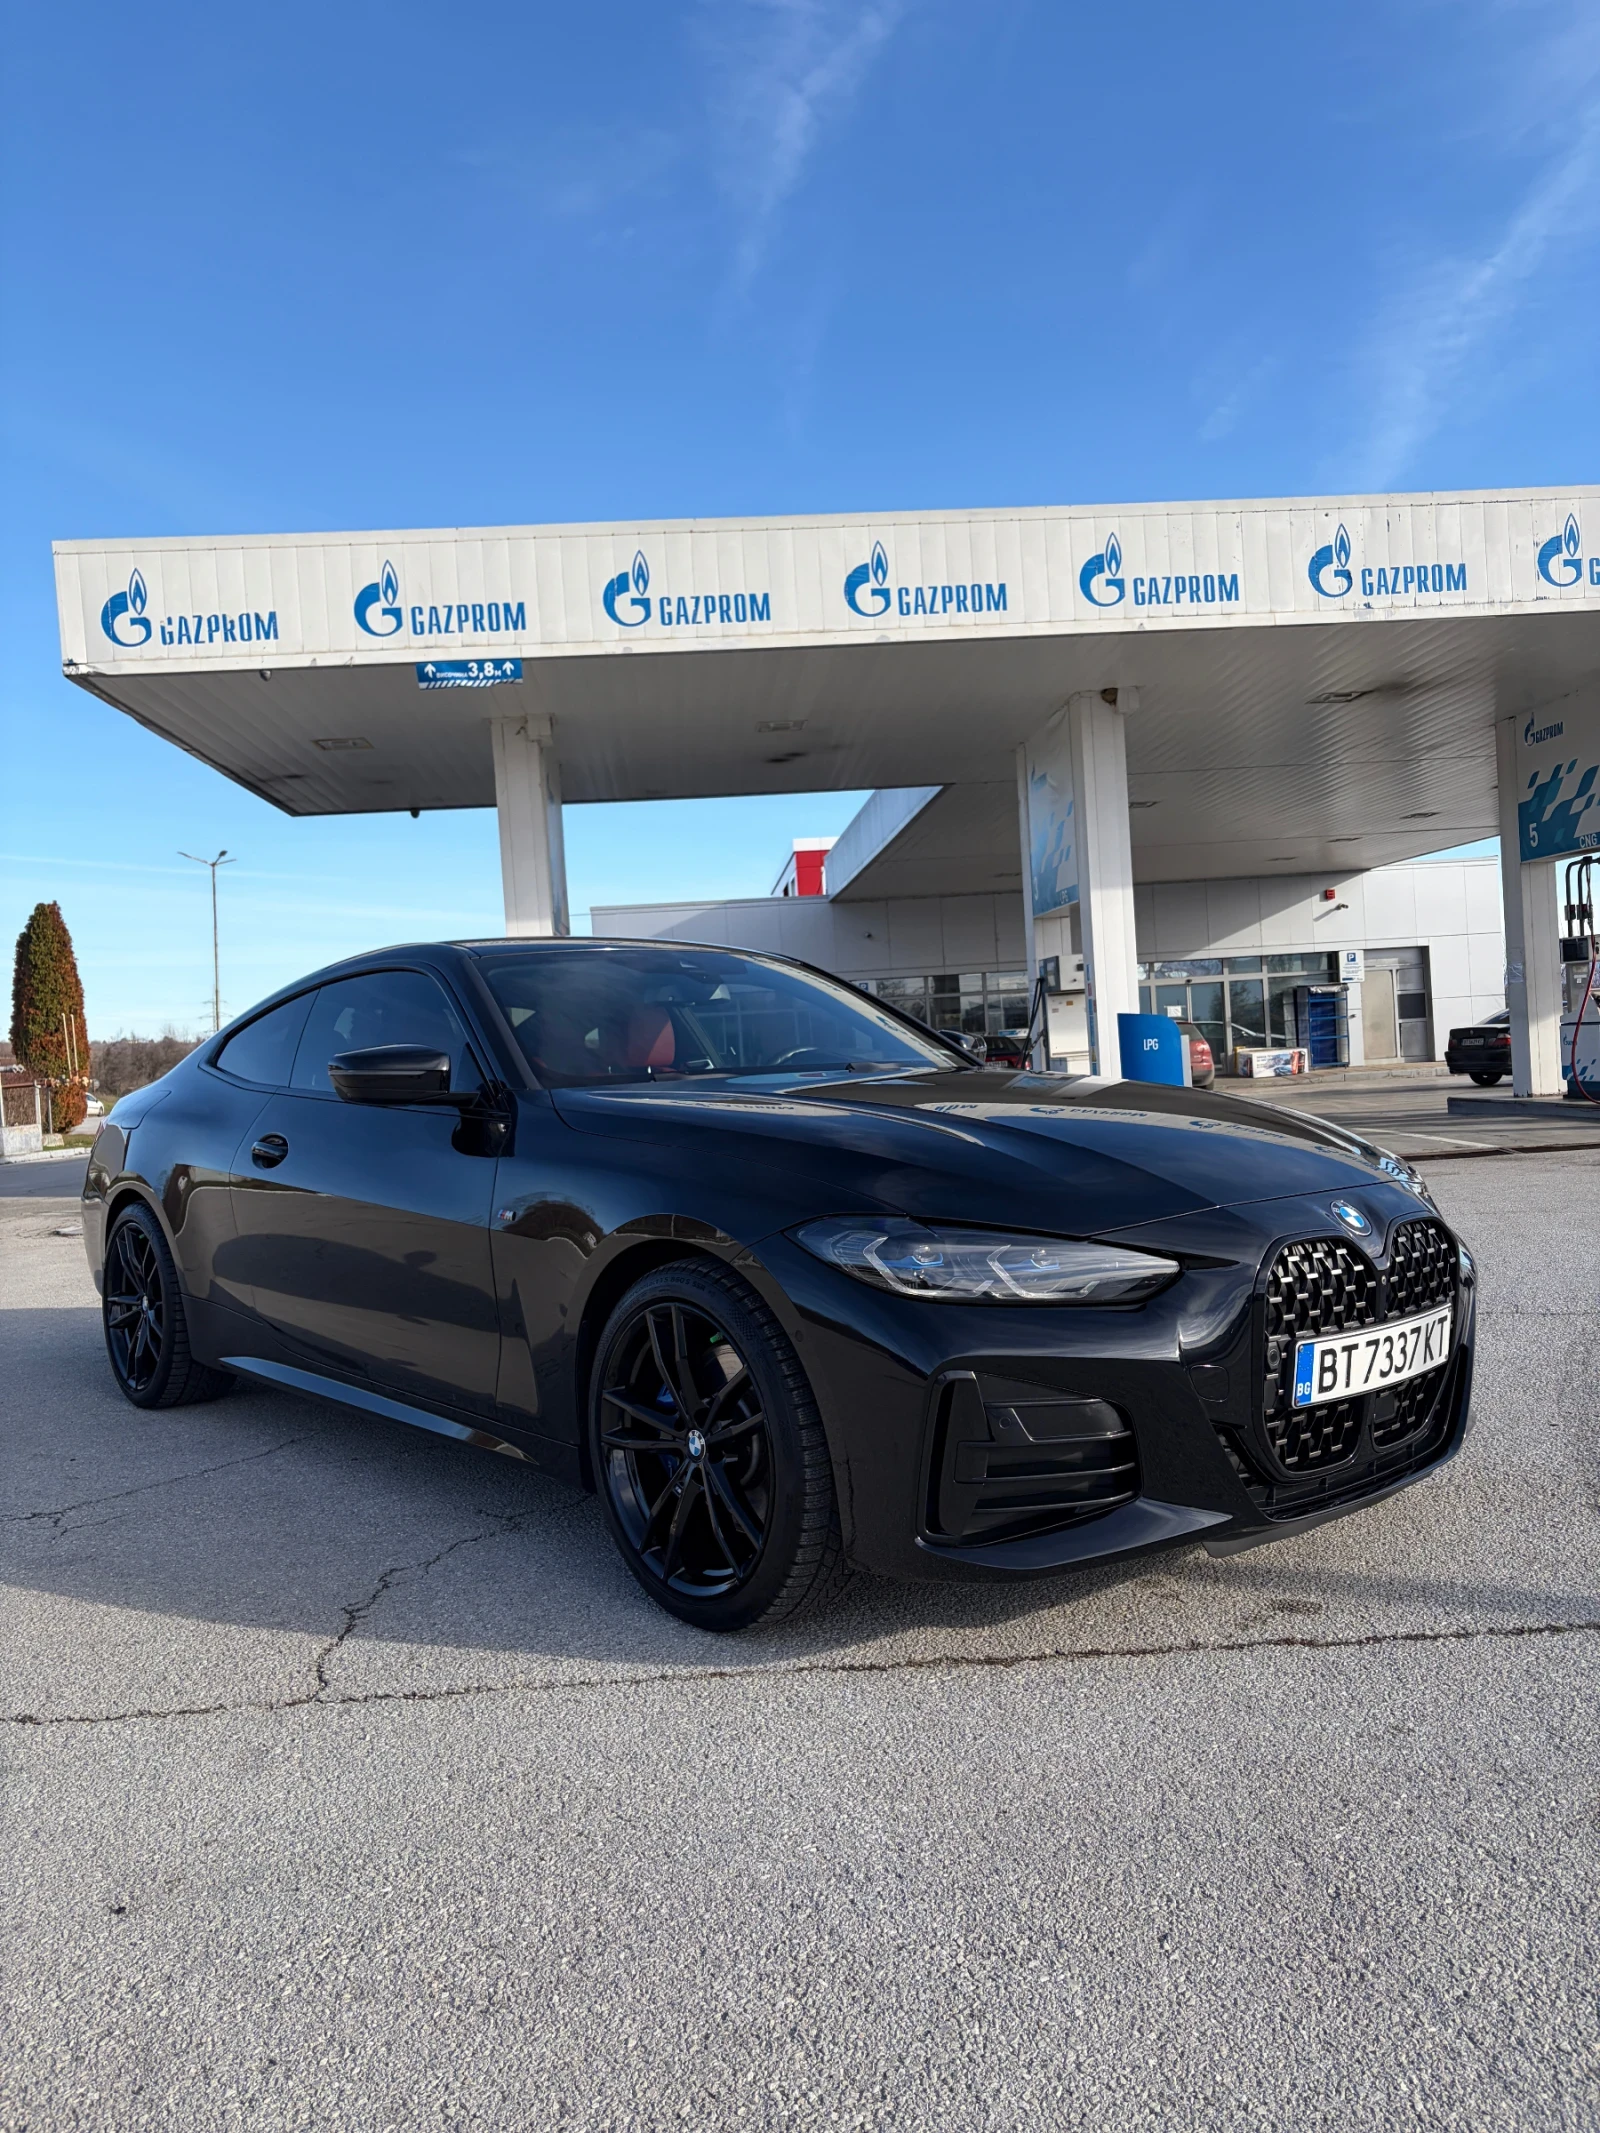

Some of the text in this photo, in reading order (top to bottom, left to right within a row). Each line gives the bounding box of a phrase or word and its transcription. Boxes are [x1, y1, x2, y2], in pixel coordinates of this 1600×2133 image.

[1133, 573, 1240, 606] GAZPROM
[1361, 563, 1467, 597] GAZPROM
[659, 592, 771, 627] GAZPROM
[897, 583, 1008, 617] GAZPROM
[160, 611, 279, 646] GAZPROM
[411, 601, 527, 636] GAZPROM
[1535, 721, 1564, 744] GAZPROM
[1529, 823, 1539, 848] 5
[1579, 833, 1598, 849] CNG
[1143, 1038, 1159, 1051] LPG
[1297, 1381, 1311, 1397] BG
